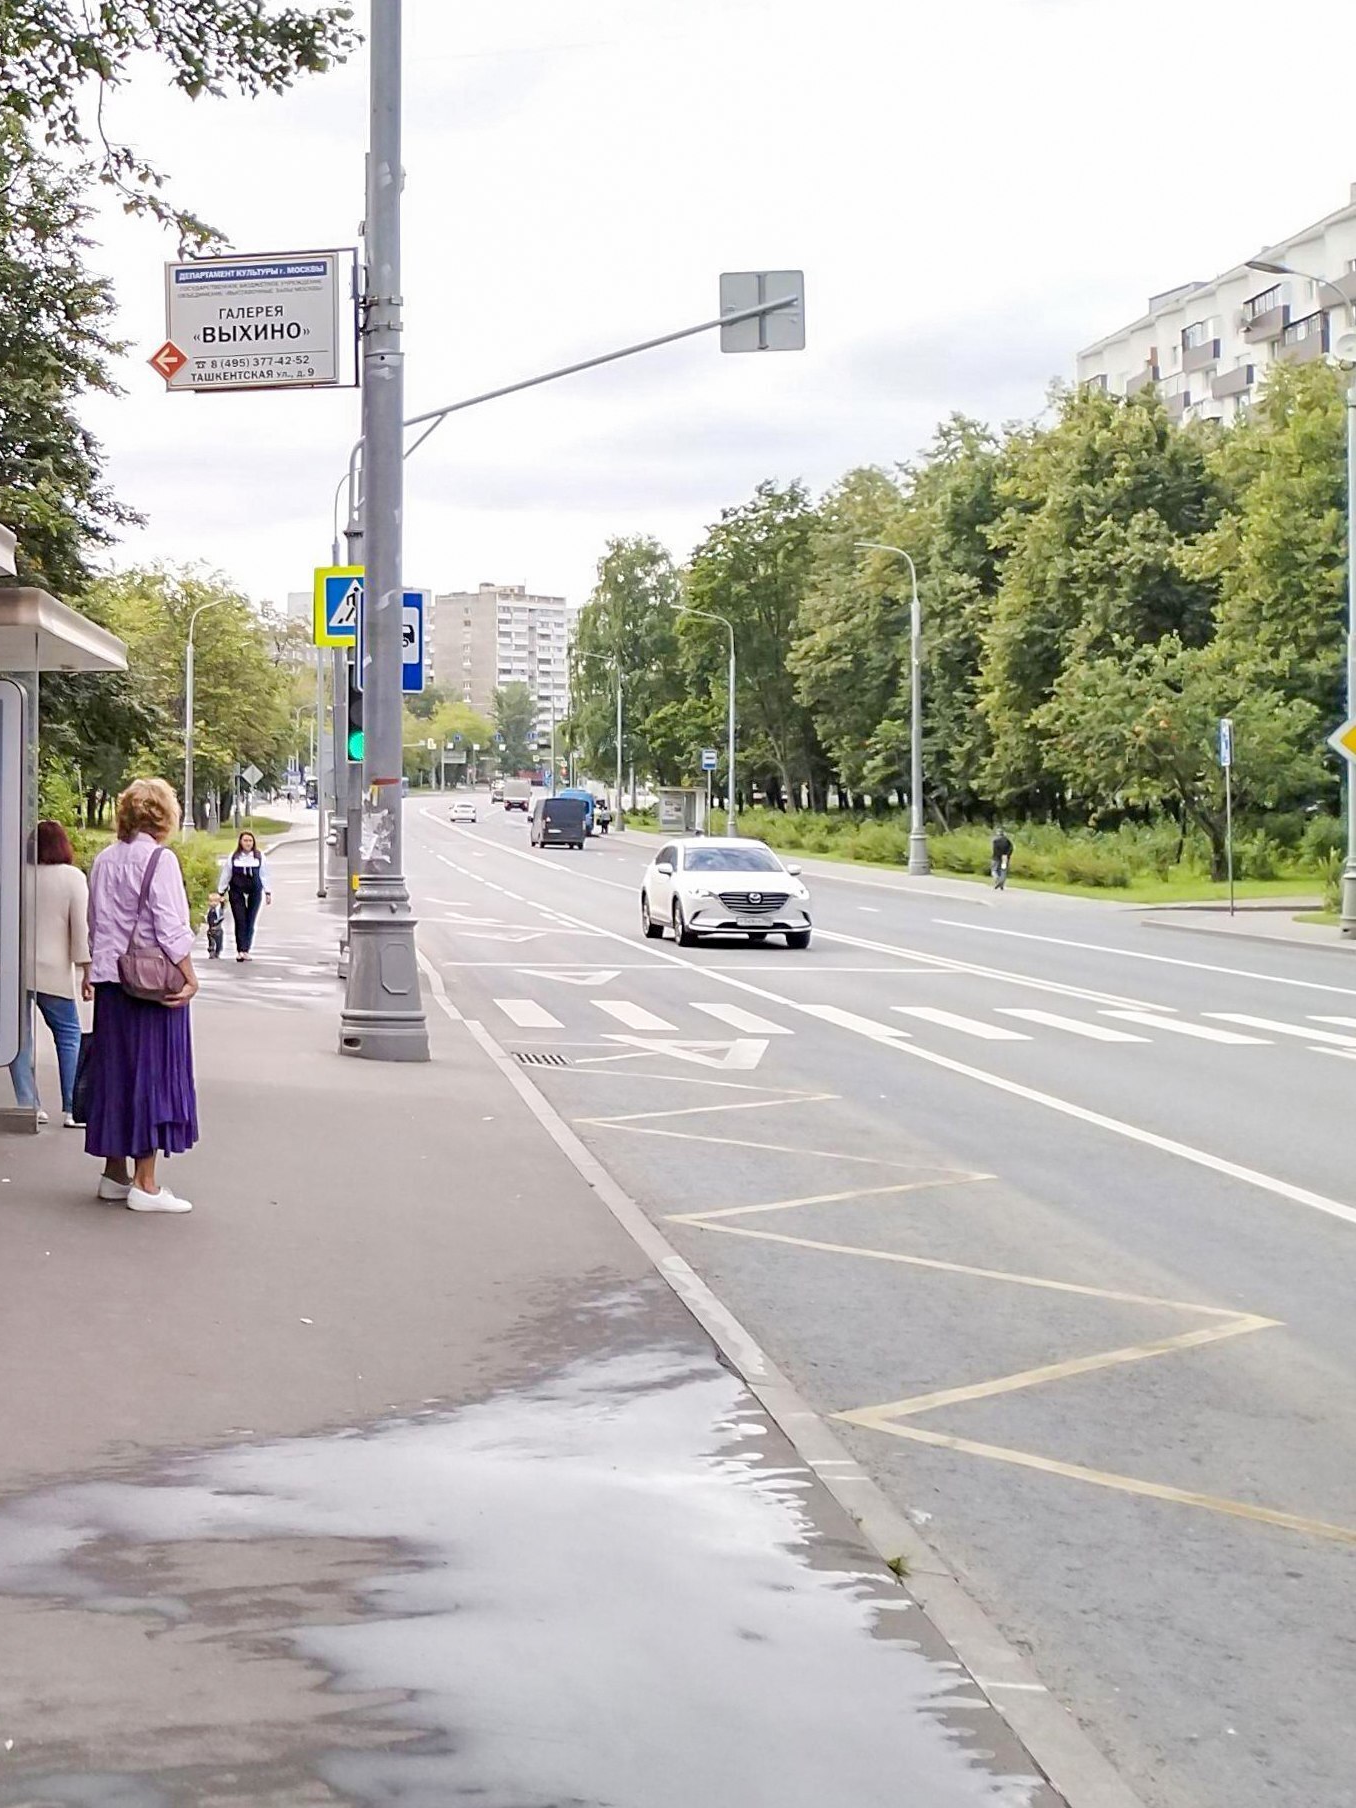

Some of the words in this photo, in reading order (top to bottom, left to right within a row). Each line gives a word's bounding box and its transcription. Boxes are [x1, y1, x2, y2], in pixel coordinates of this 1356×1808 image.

[179, 270, 235, 281] ДЕПАРТАМЕНТ
[236, 267, 280, 278] КУЛЬТУРЫ
[287, 265, 324, 274] МОСКВЫ
[219, 305, 284, 320] ГАЛЕРЕЯ
[193, 322, 310, 343] «ВЫХИНО»
[210, 359, 218, 368] 8
[220, 358, 250, 369] (495)
[252, 355, 310, 367] 377-42-52
[191, 370, 274, 382] ТАШКЕНТСКАЯ
[307, 368, 315, 377] 9
